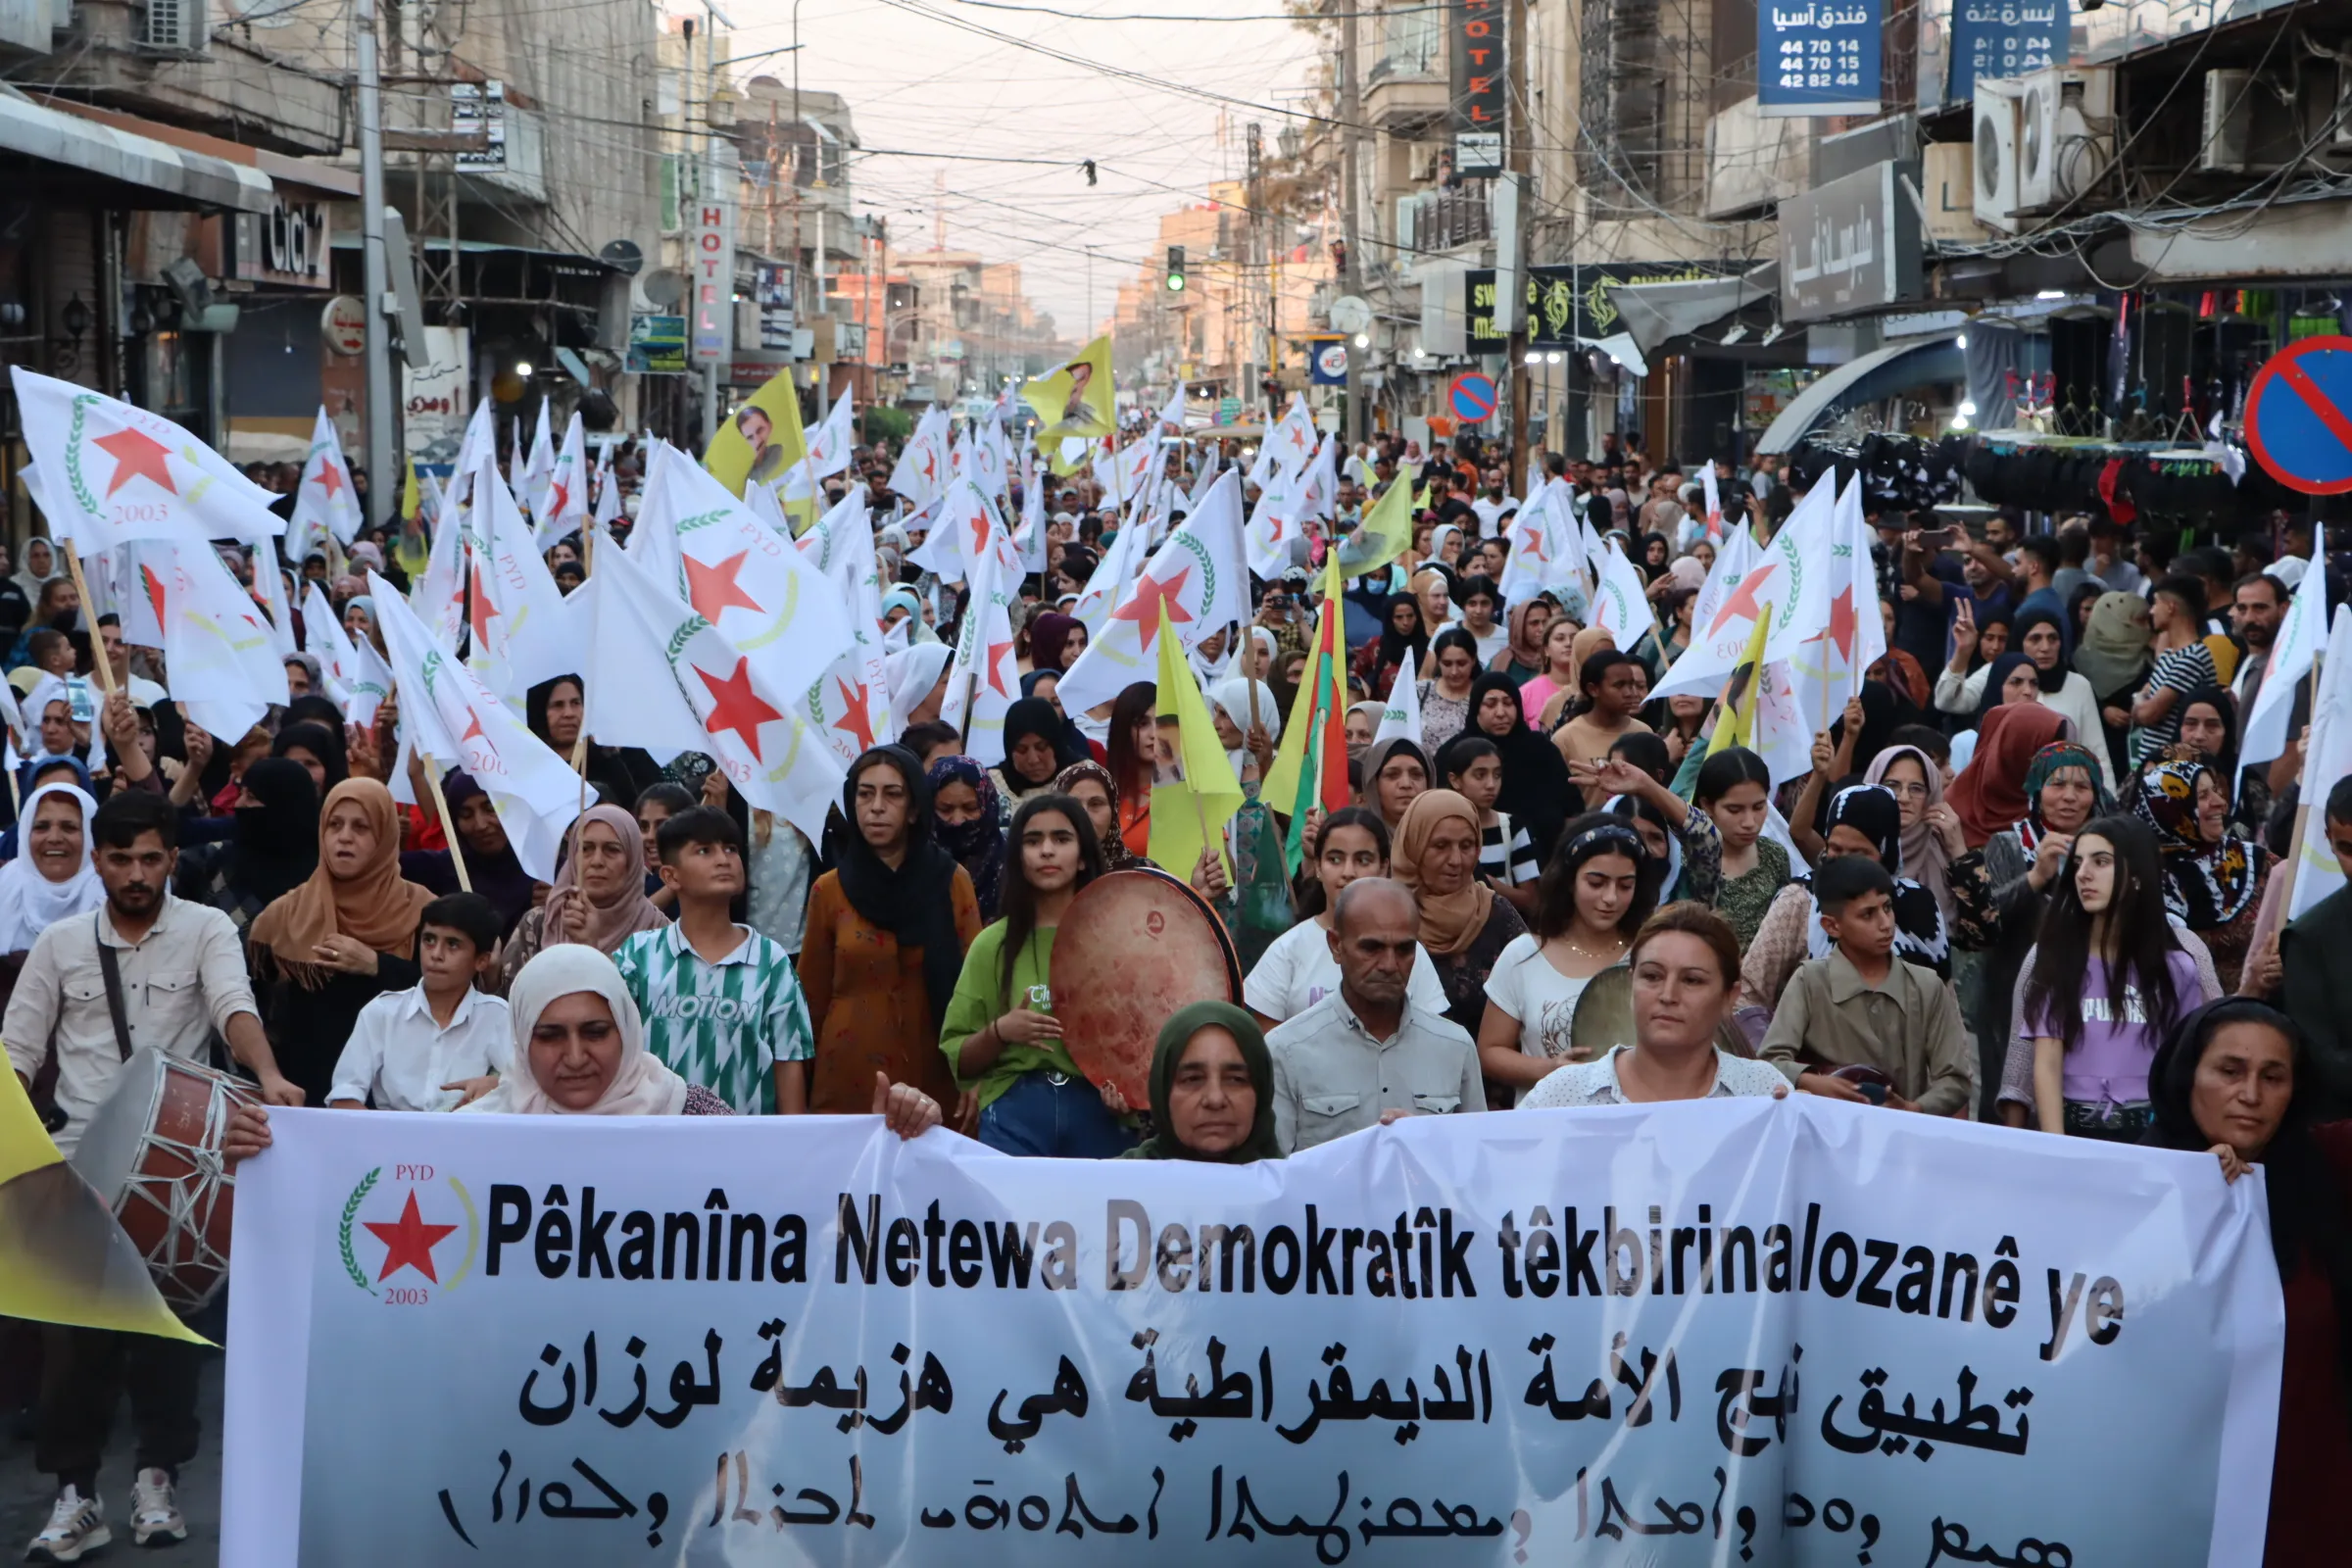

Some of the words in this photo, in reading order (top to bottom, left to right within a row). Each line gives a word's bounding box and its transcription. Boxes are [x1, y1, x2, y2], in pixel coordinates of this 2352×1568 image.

[1772, 2, 1816, 32] آسيا
[1816, 5, 1868, 29] فندق
[1780, 40, 1804, 55] 44
[1808, 39, 1832, 54] 70
[1838, 38, 1860, 53] 14
[1780, 57, 1804, 72] 44
[1808, 57, 1832, 71] 70
[1837, 56, 1860, 70] 15
[1780, 74, 1804, 88] 42
[1808, 74, 1832, 87] 82
[1836, 73, 1860, 86] 44
[700, 206, 721, 331] HOTEL
[114, 503, 169, 525] 2003
[739, 522, 782, 557] PYD
[499, 554, 527, 590] PYD
[653, 994, 760, 1025] MOTION
[394, 1163, 434, 1182] PYD
[485, 1184, 808, 1284] Pêkanîna
[834, 1193, 1078, 1291] Netewa
[1105, 1199, 1477, 1300] Demokratîk
[2038, 1267, 2125, 1362] ye
[384, 1287, 429, 1305] 2003
[518, 1327, 723, 1430] لوزان
[749, 1317, 954, 1436] هزيمة
[1124, 1327, 1493, 1446] الديمقراطية
[987, 1353, 1089, 1455] هي
[1820, 1364, 2034, 1463] تطبيق
